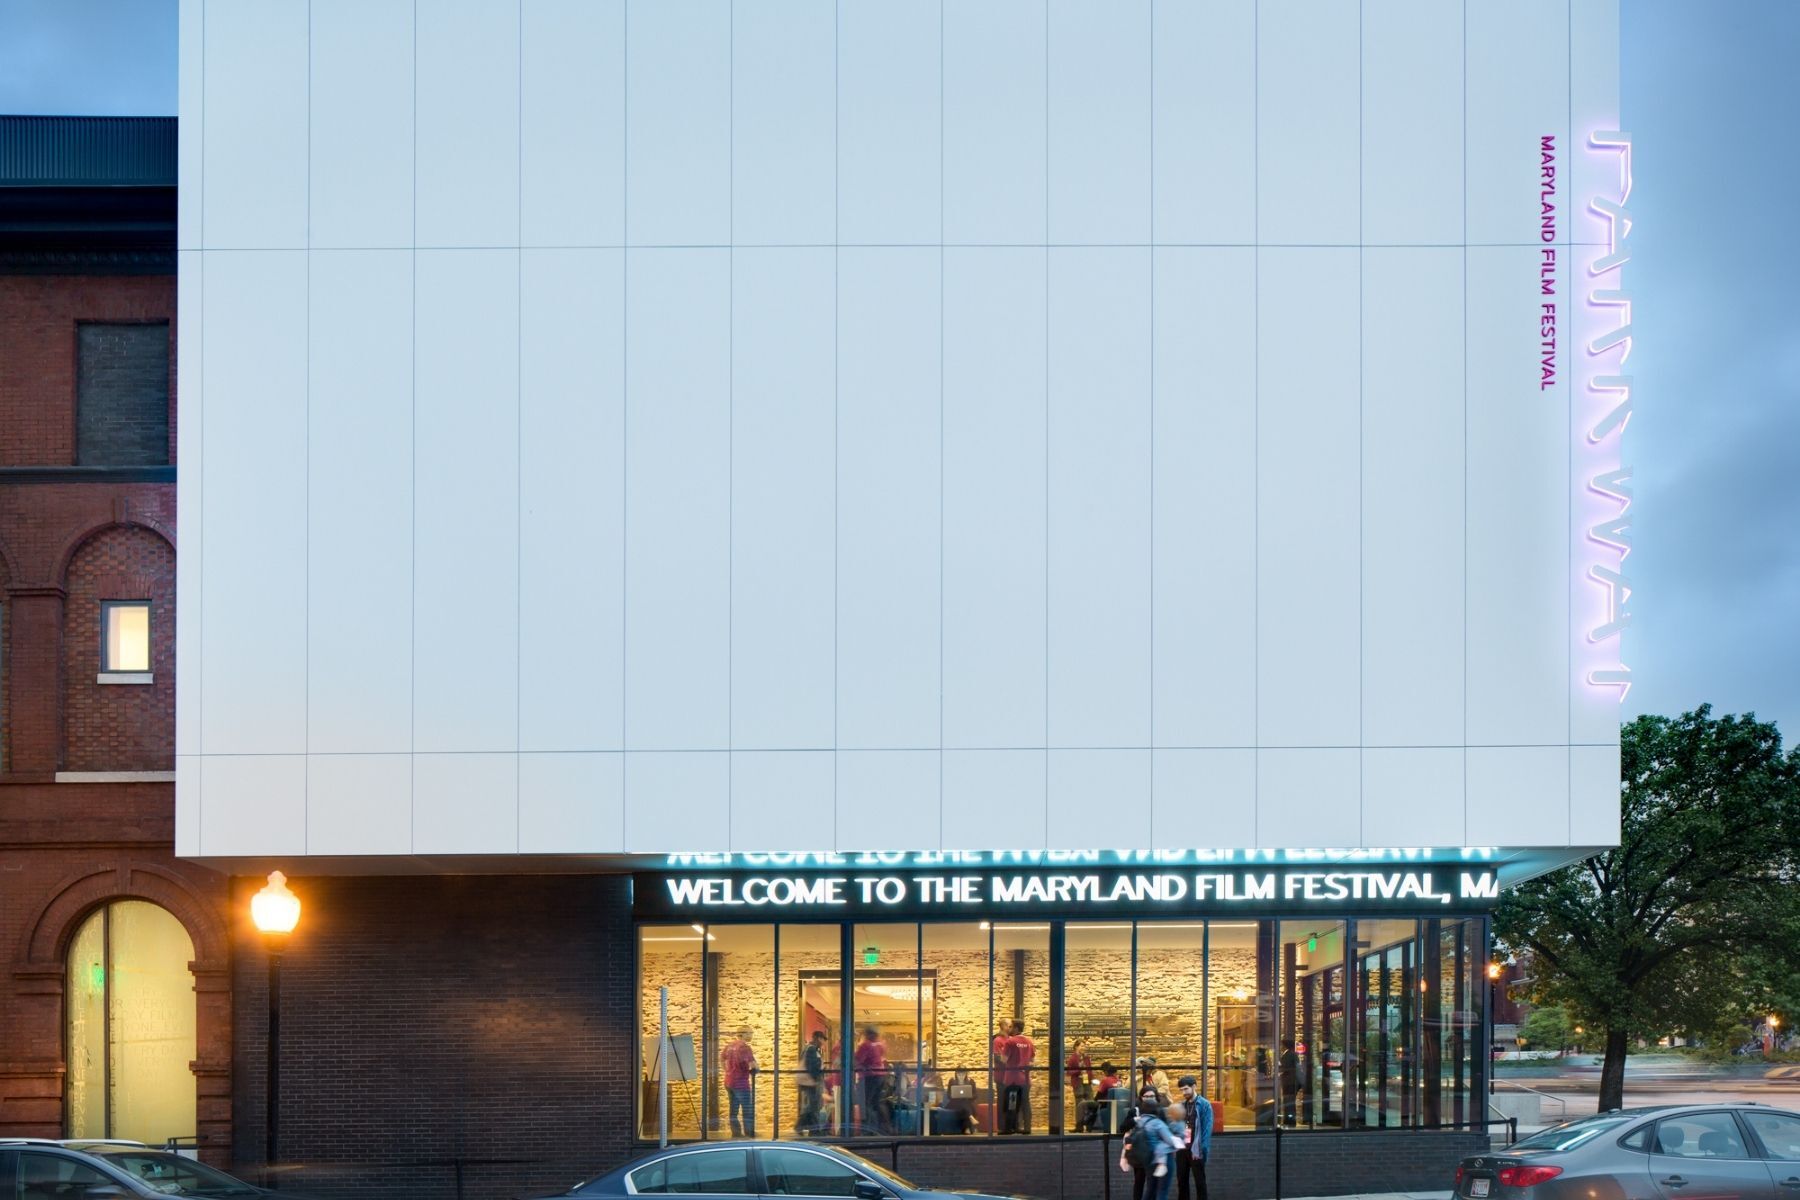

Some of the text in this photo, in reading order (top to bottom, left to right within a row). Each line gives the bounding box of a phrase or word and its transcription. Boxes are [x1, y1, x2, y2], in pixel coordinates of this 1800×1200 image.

[1540, 135, 1556, 391] MARYLAND FILM FESTIVAL
[666, 877, 848, 906] WELCOME
[854, 877, 907, 905] TO
[912, 876, 986, 905] THE
[989, 874, 1188, 905] MARYLAND
[1195, 873, 1276, 901] FILM
[1284, 872, 1451, 905] FESTIVAL,
